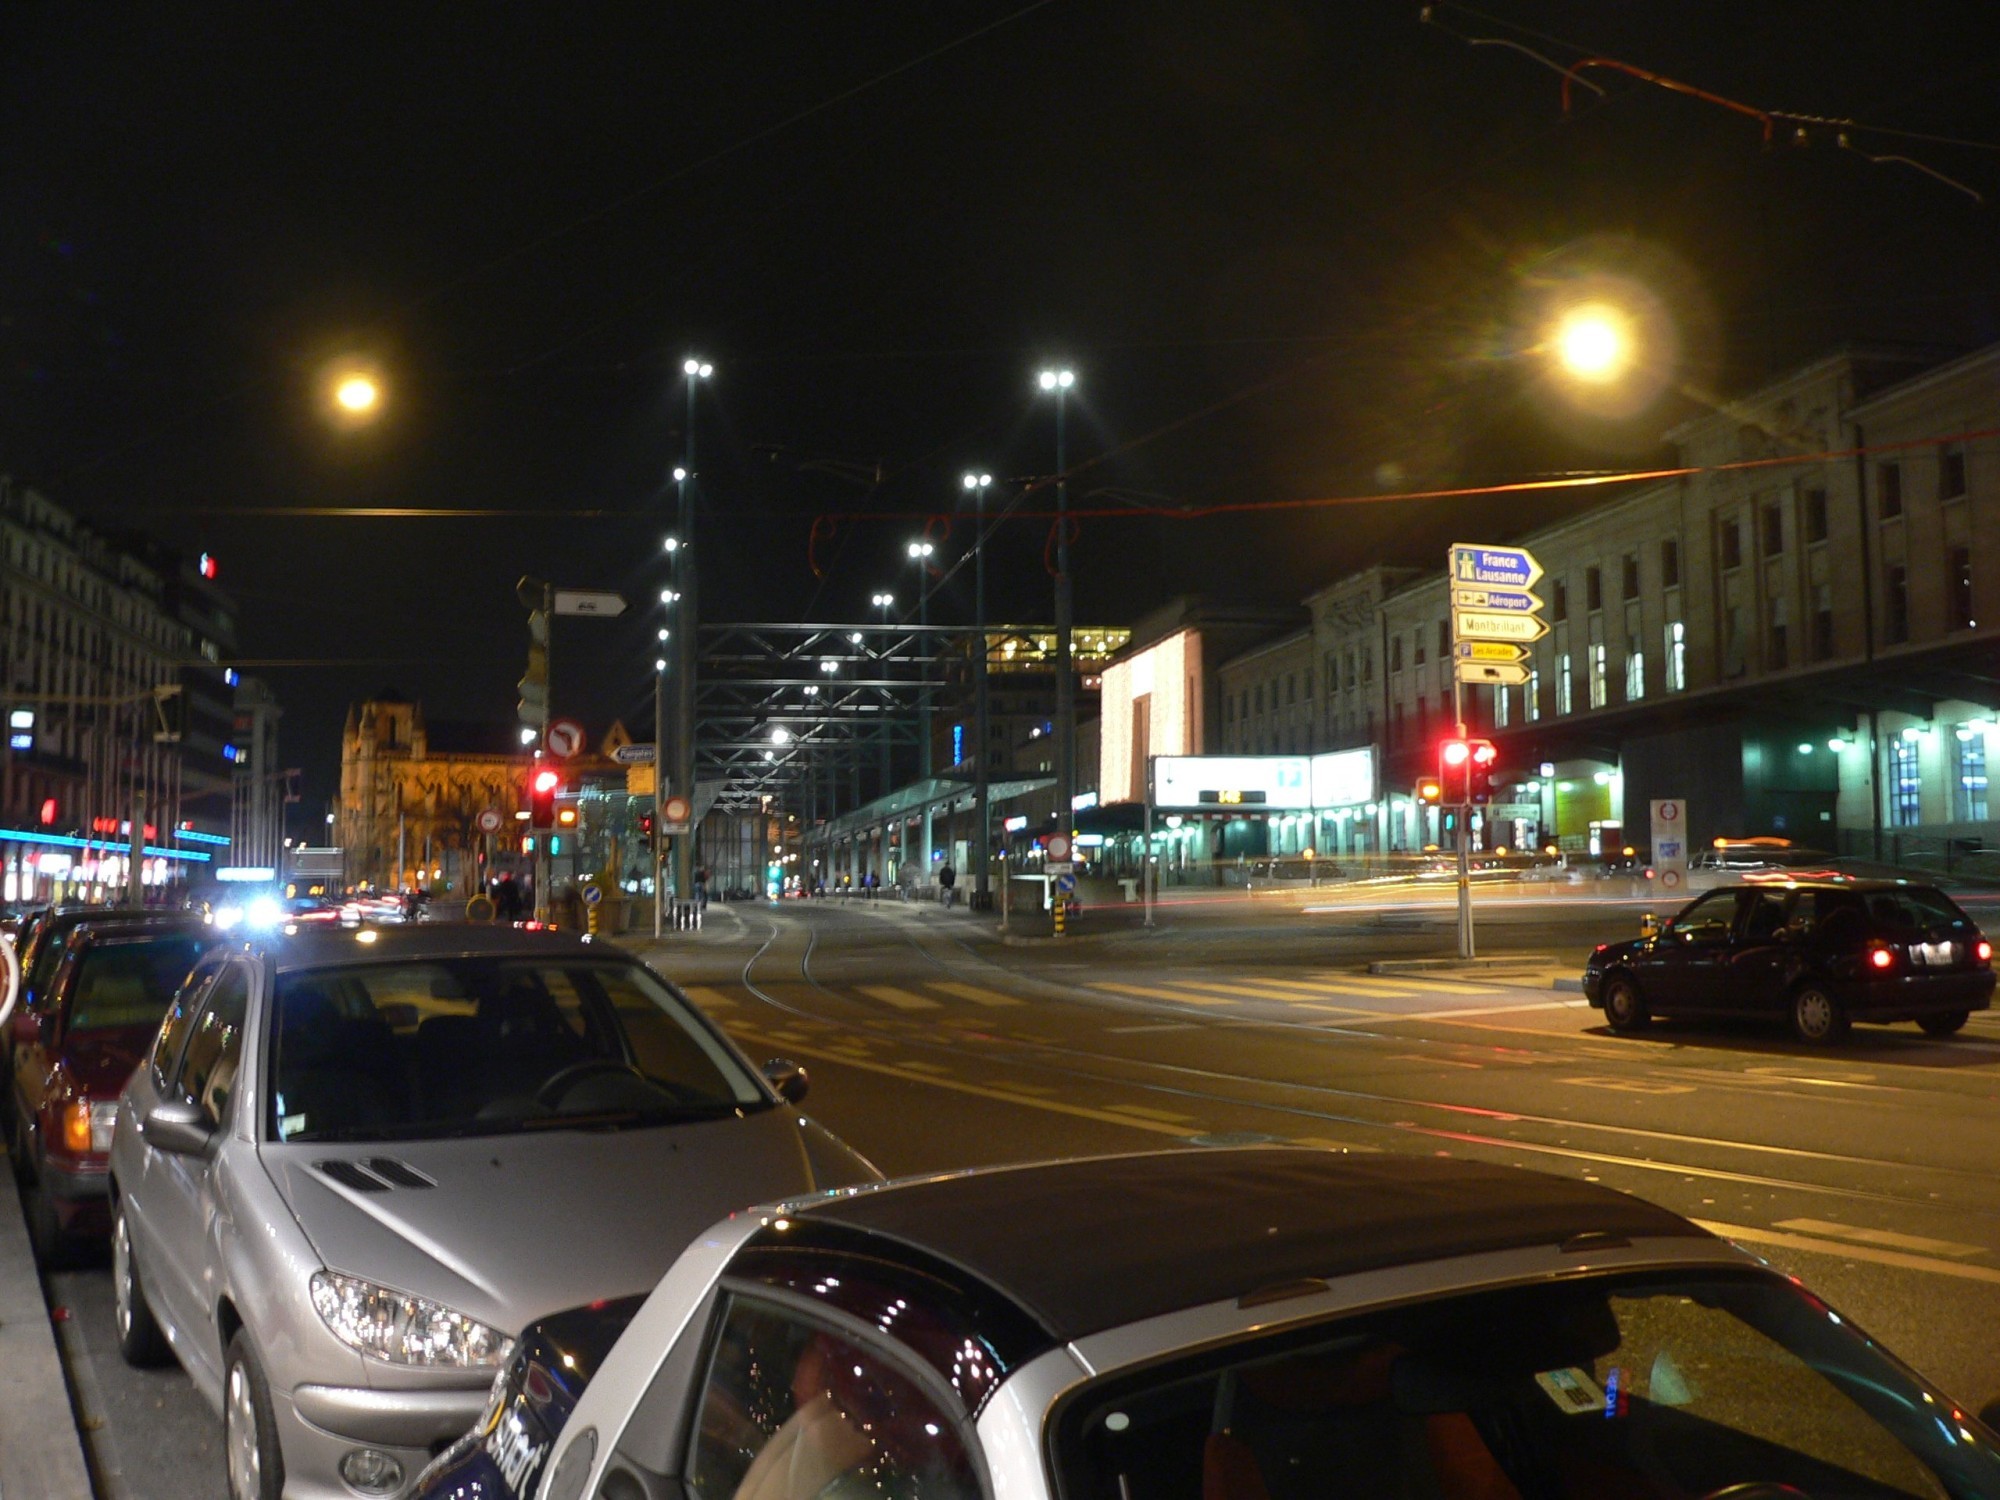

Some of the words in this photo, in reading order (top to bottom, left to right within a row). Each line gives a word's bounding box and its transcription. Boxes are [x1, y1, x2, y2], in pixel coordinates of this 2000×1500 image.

[1483, 553, 1517, 568] France
[1476, 567, 1526, 583] Lausanne
[1489, 593, 1528, 609] Aéroport
[1466, 619, 1525, 634] Montbrillant
